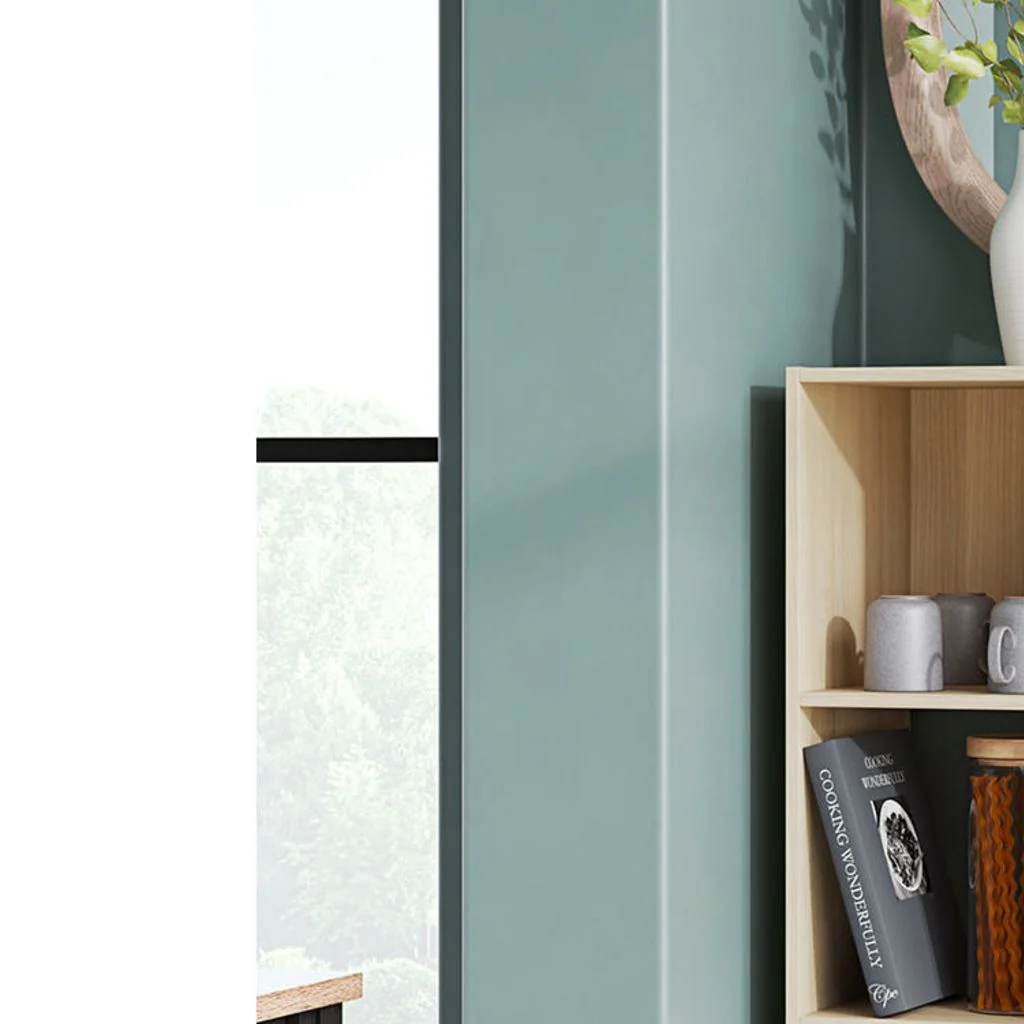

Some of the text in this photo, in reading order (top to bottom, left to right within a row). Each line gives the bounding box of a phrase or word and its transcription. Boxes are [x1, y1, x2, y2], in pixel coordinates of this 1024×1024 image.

[864, 753, 893, 769] COOKING
[819, 769, 883, 968] COOKING WONDERFULLY
